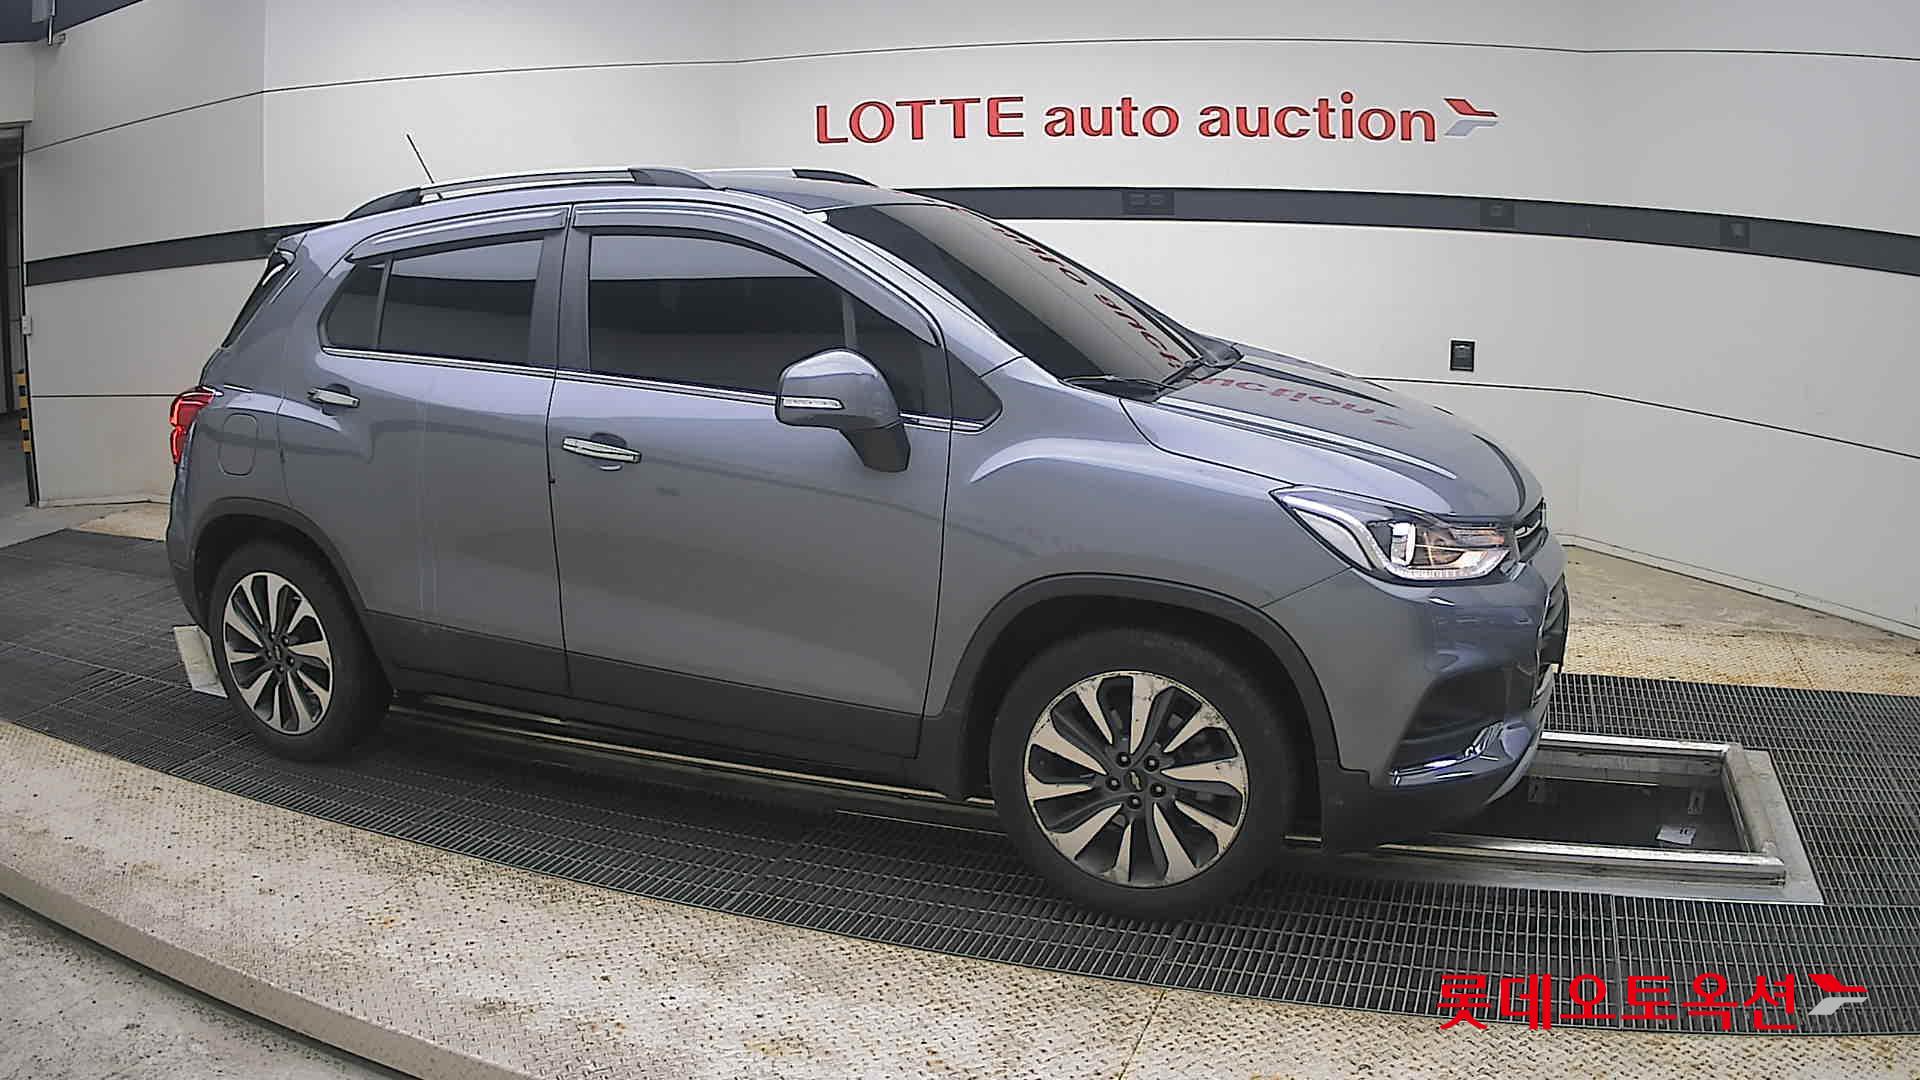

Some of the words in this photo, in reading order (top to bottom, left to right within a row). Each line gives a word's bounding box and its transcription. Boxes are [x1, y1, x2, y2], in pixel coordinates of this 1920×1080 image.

[815, 95, 1024, 144] LOTTE
[1043, 96, 1180, 137] auto
[1197, 91, 1437, 142] auction
